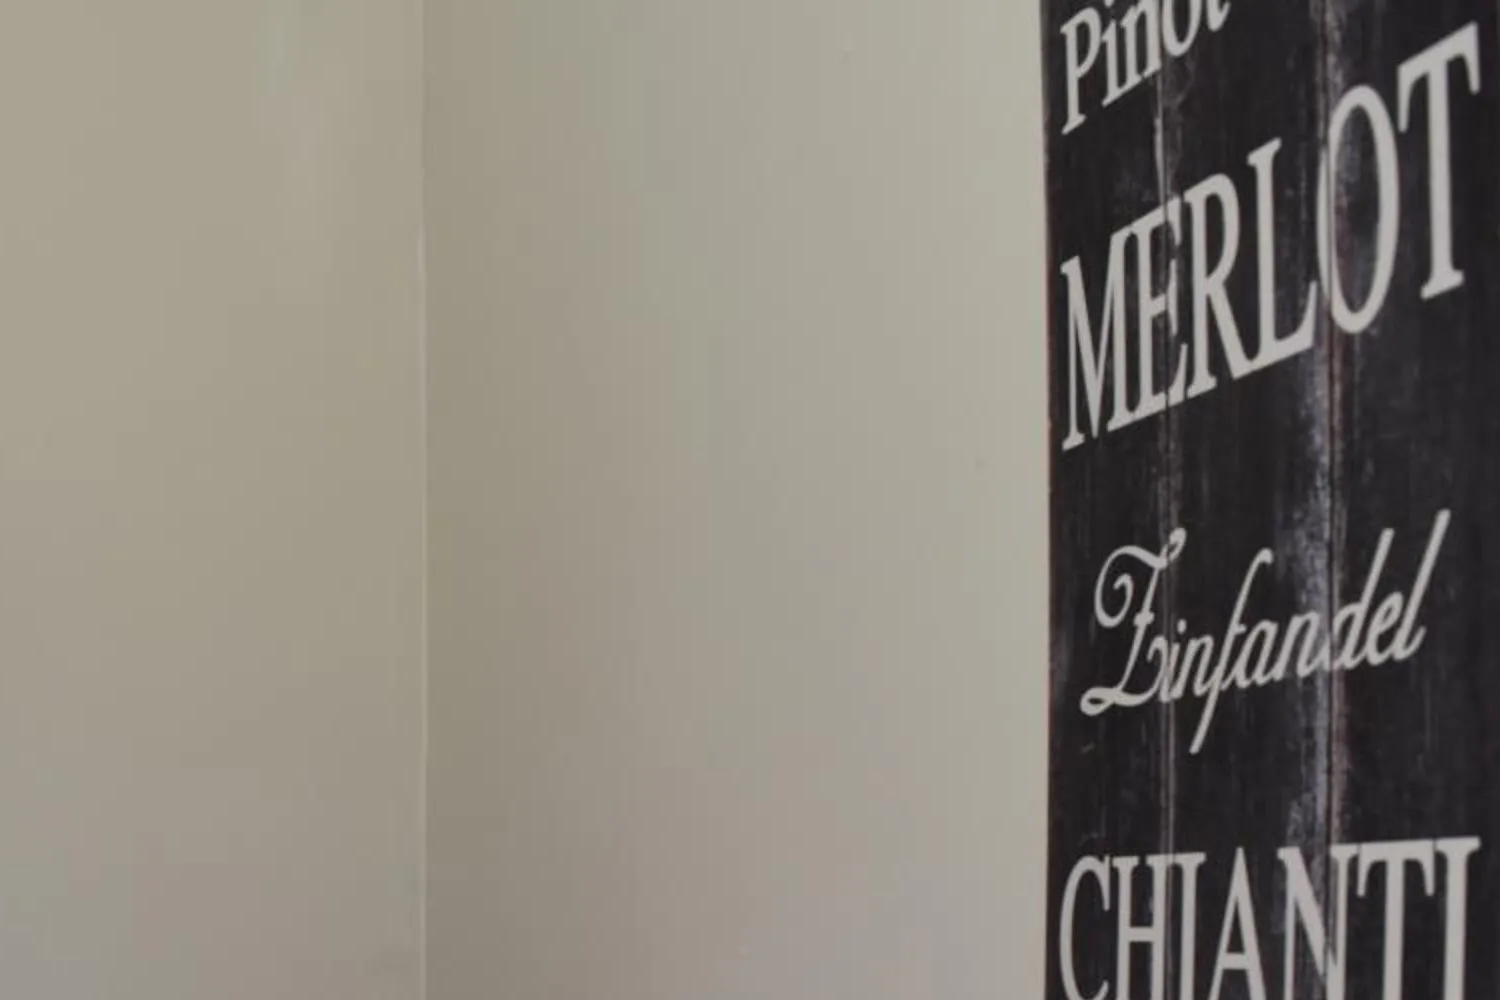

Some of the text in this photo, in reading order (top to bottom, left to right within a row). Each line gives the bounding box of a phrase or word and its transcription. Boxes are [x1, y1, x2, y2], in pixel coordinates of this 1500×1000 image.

[1060, 0, 1231, 135] Pino
[1060, 22, 1480, 451] MERLOT
[1080, 509, 1451, 754] Zinfandel
